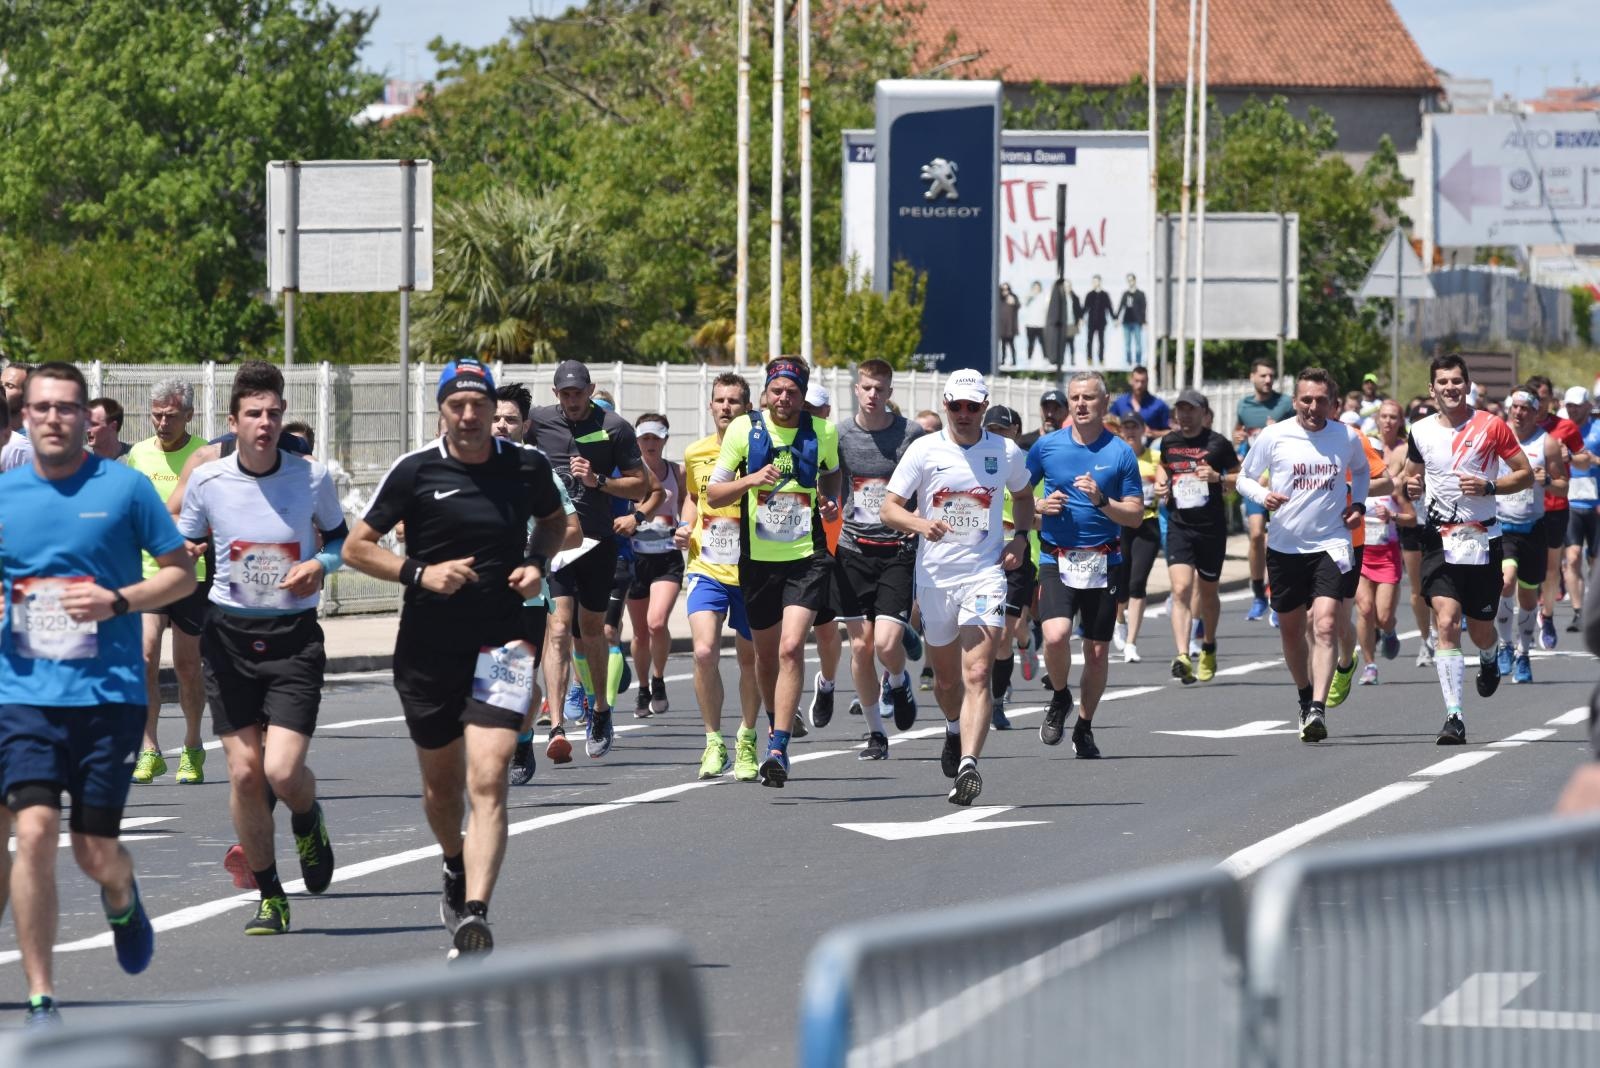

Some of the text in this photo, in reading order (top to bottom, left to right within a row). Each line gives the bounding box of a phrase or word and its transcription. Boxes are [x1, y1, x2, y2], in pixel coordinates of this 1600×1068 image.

[899, 206, 981, 218] PEUGEOT
[1293, 463, 1338, 476] NO LIMITS
[1293, 478, 1335, 491] RUNNING
[765, 513, 801, 526] 33210
